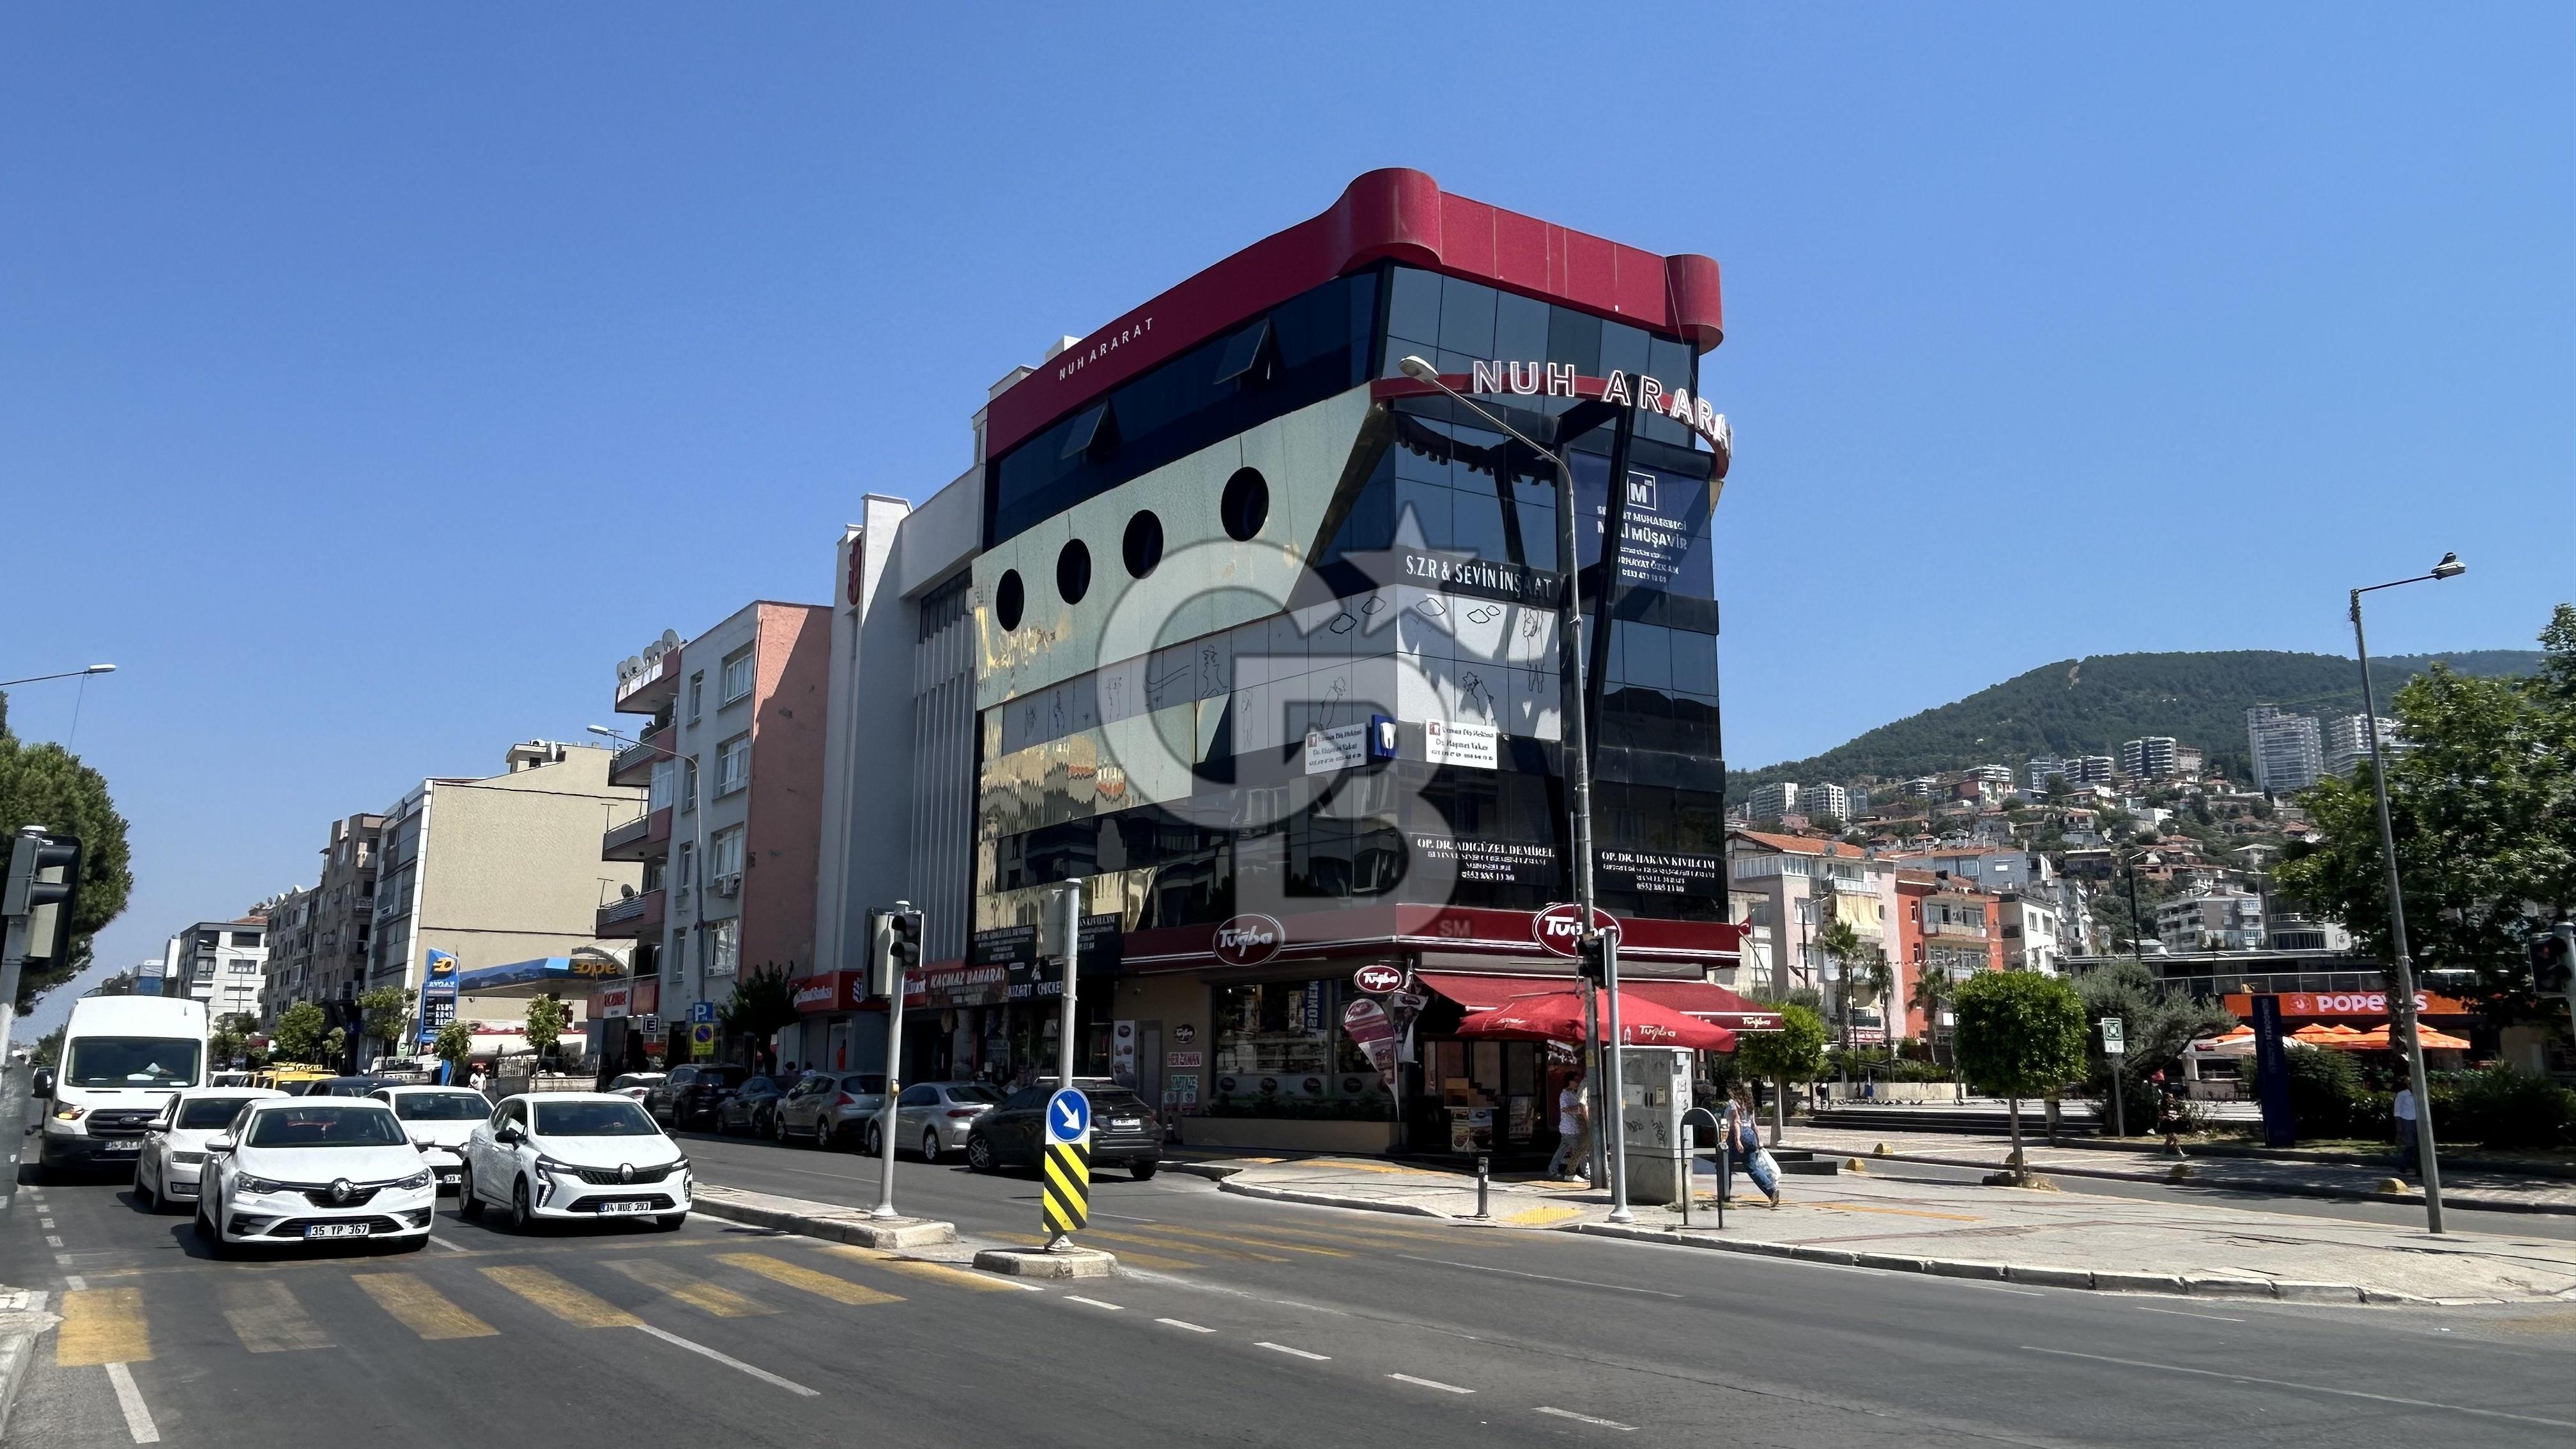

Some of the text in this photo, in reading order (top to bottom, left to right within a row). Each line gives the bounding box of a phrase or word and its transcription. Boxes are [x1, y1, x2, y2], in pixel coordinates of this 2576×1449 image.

[1059, 318, 1153, 381] NUH ARARAT
[1473, 360, 1733, 459] NUH ARARA
[1630, 482, 1648, 503] M
[1631, 526, 1687, 550] MÜŞAVİR
[1406, 555, 1552, 598] S.Z.R & SEVİN İNŞAAT
[695, 1004, 707, 1022] P
[312, 1226, 325, 1236] 35
[349, 1224, 367, 1234] 367
